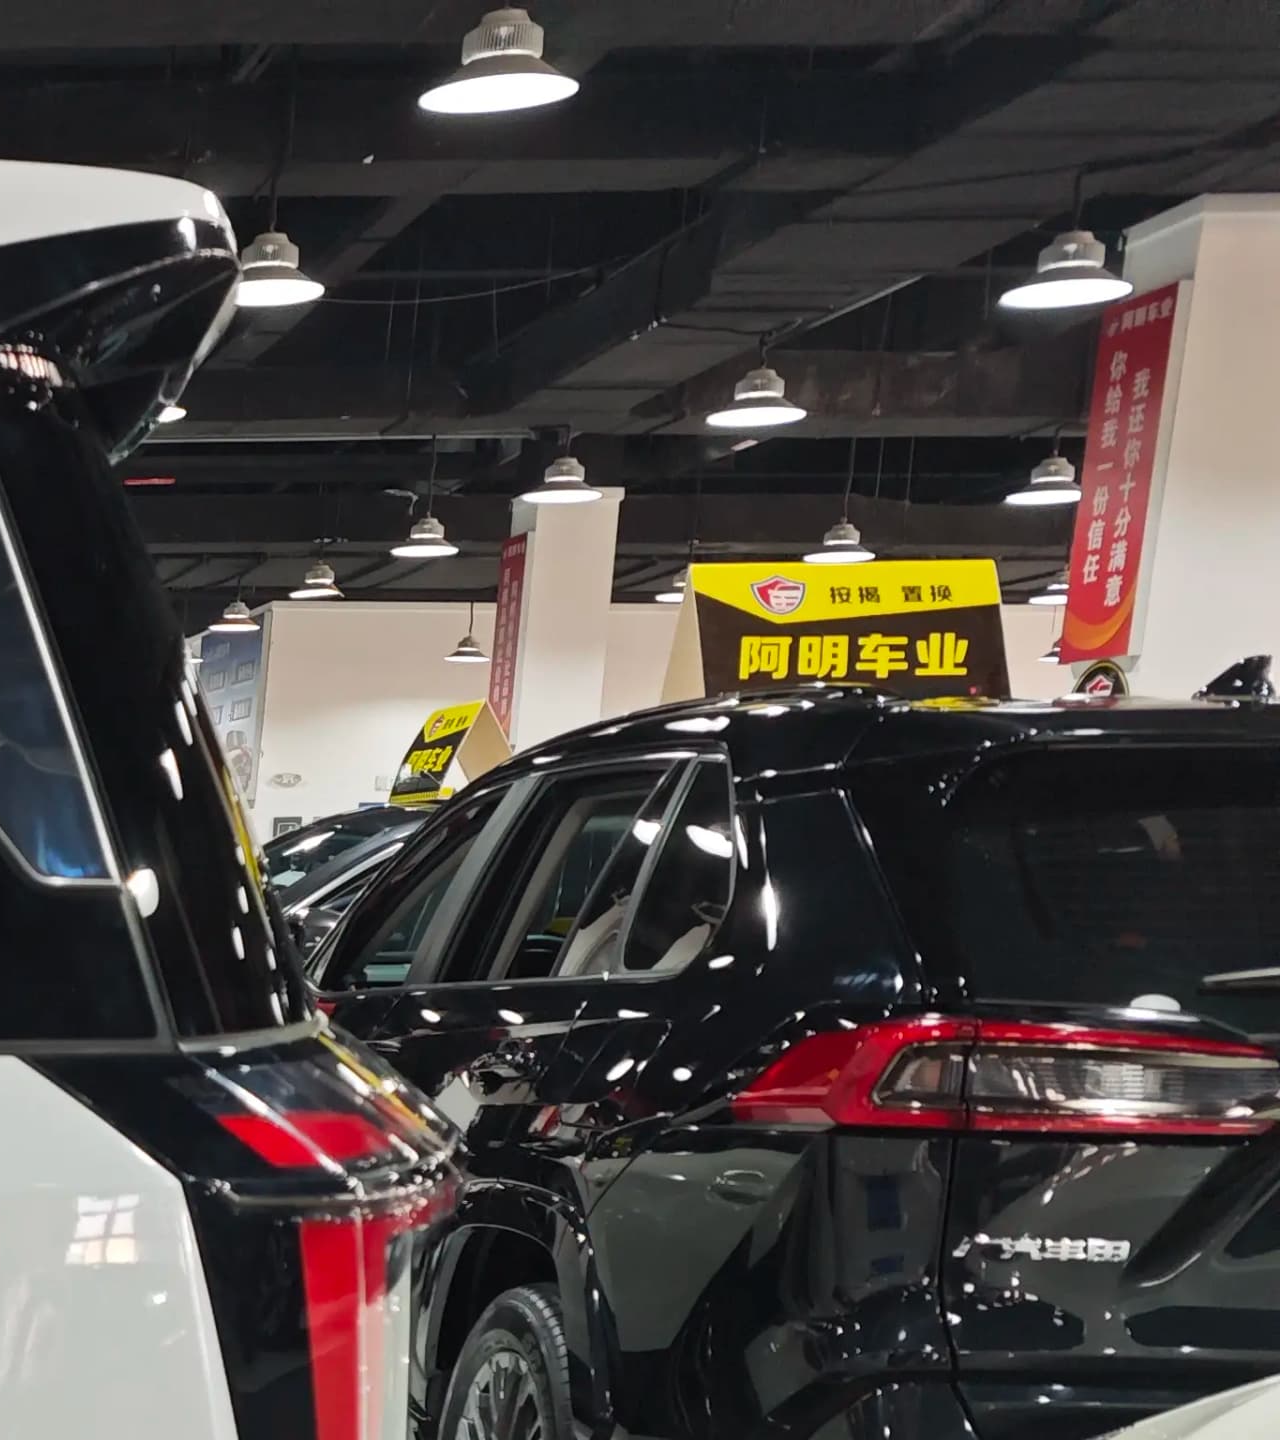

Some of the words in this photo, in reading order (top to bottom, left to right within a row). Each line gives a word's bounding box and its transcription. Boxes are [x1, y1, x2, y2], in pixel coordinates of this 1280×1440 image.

[1082, 350, 1128, 585] 你给我一份信任
[1103, 367, 1152, 608] 我还你十分满意
[738, 632, 969, 681] 阿明车业
[829, 585, 882, 605] 按揭
[901, 584, 953, 604] 置换
